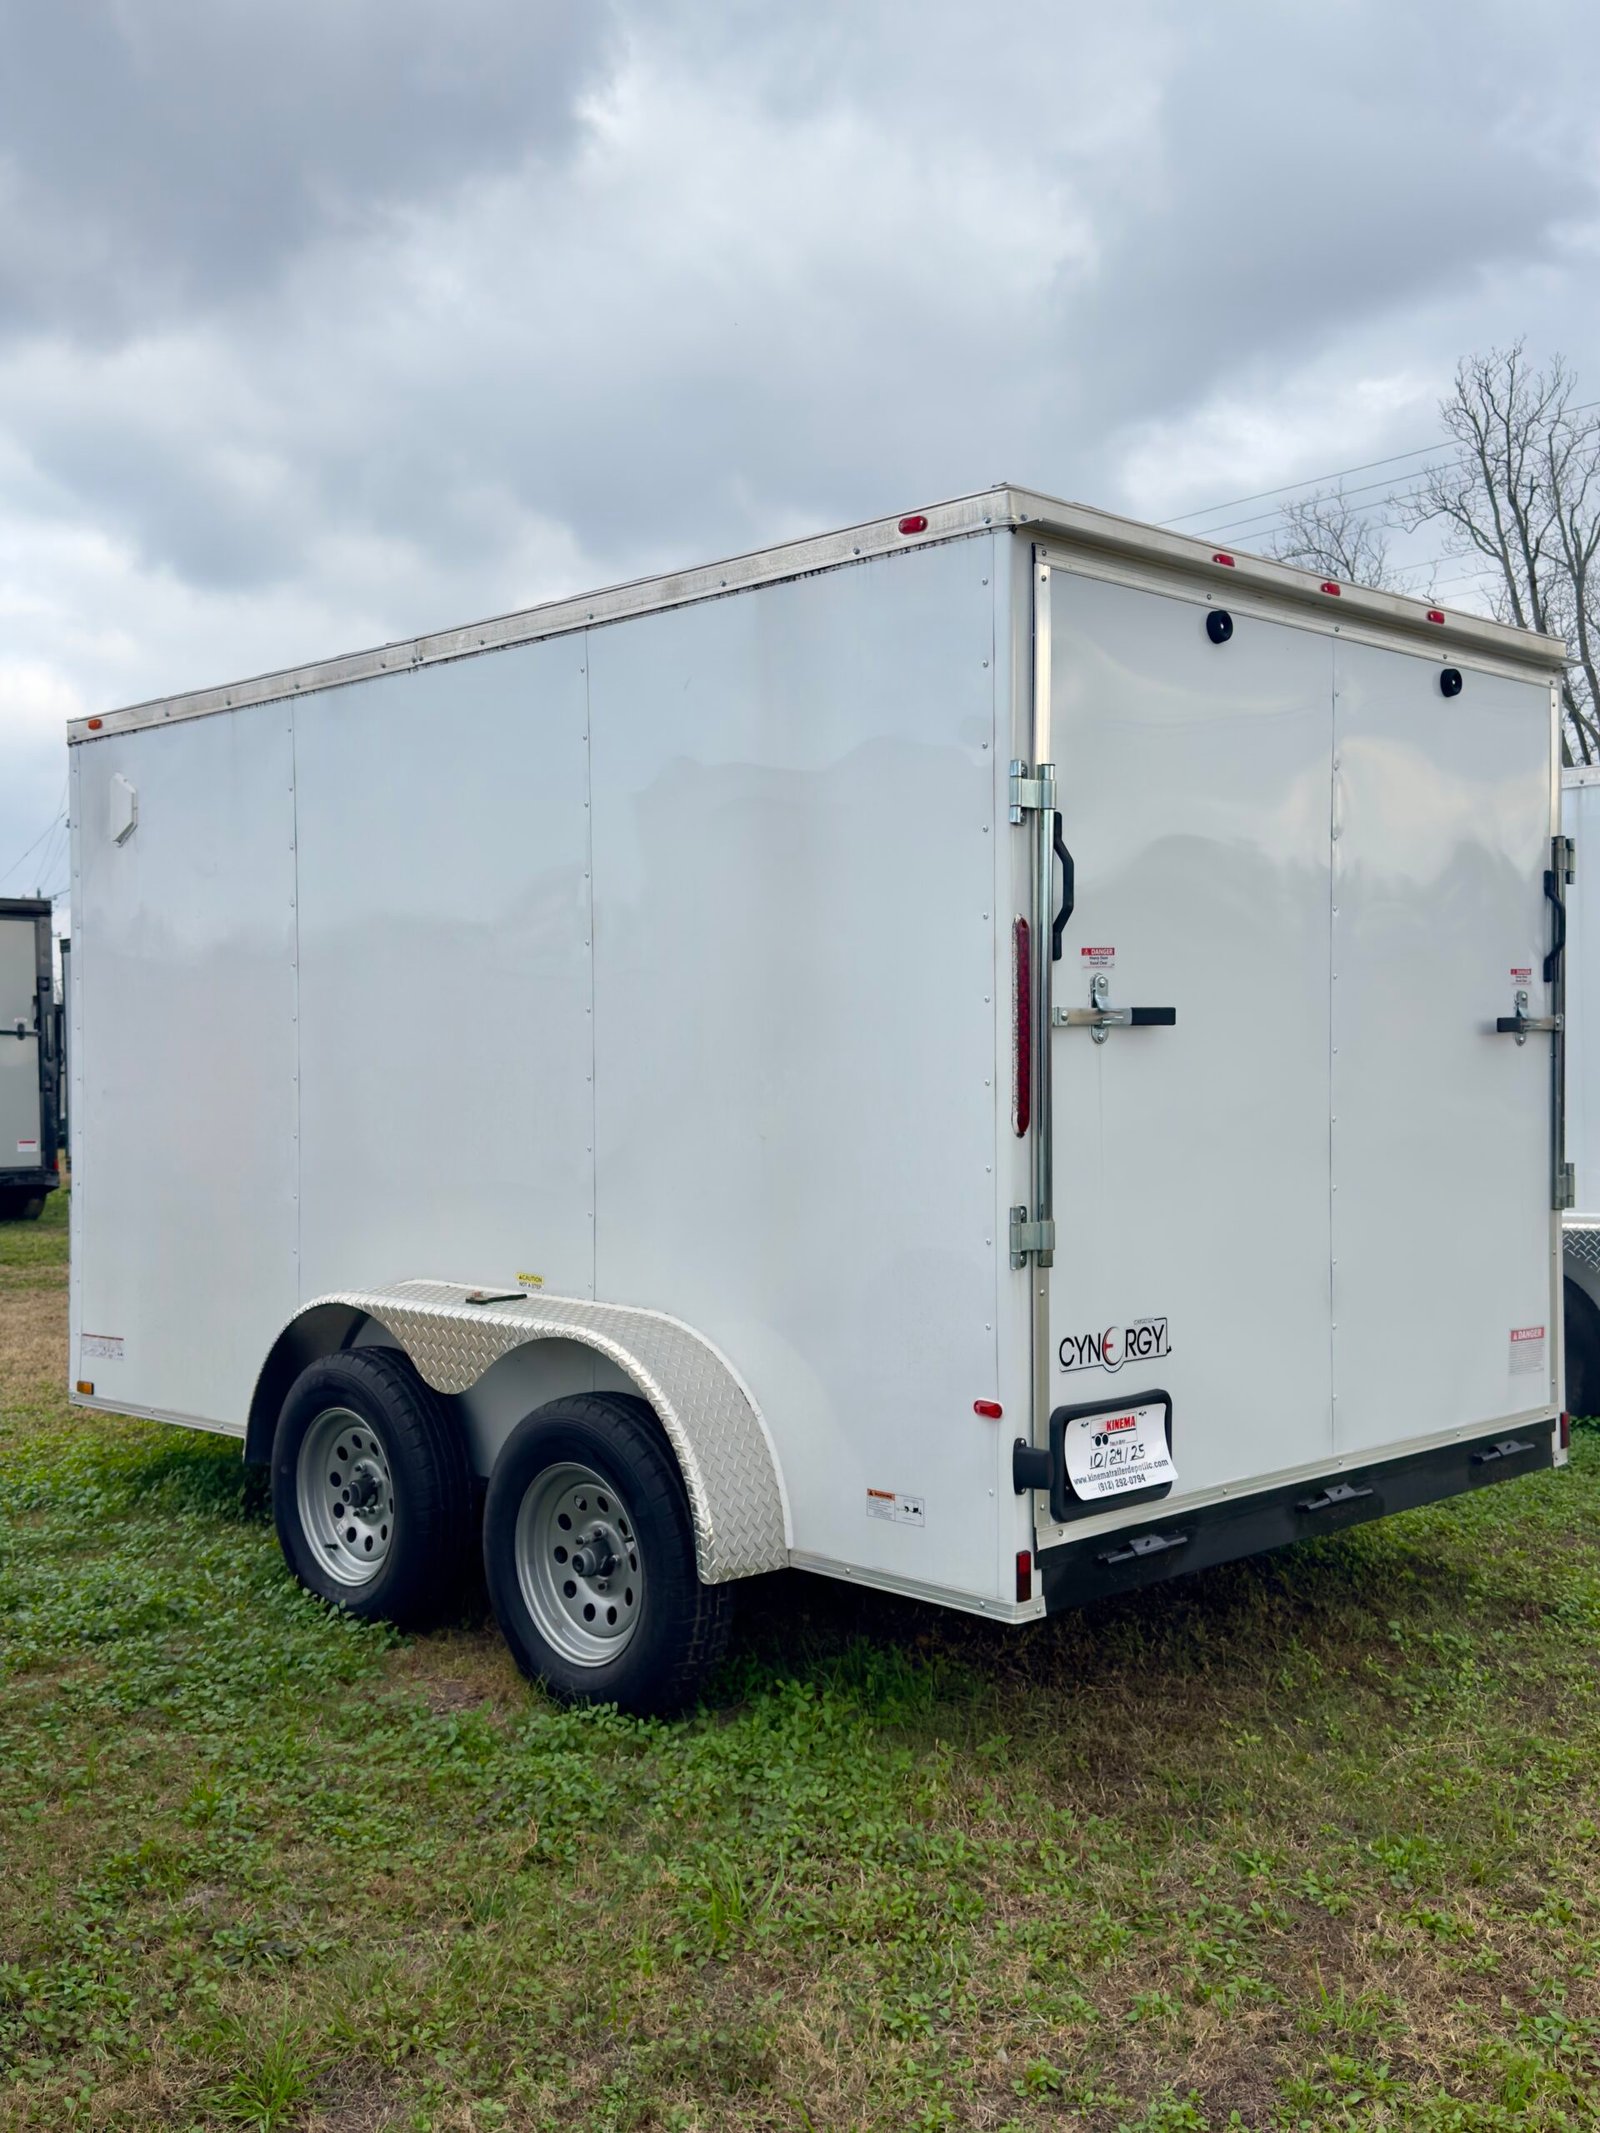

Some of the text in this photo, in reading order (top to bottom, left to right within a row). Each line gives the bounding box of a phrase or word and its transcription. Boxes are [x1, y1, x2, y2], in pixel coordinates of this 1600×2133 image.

[522, 1274, 543, 1283] CAUTION
[1518, 1328, 1542, 1339] DANGER
[1059, 1324, 1165, 1367] CYNERGY
[1106, 1415, 1136, 1432] KINEMA
[1098, 1473, 1147, 1493] (912) 292-0794
